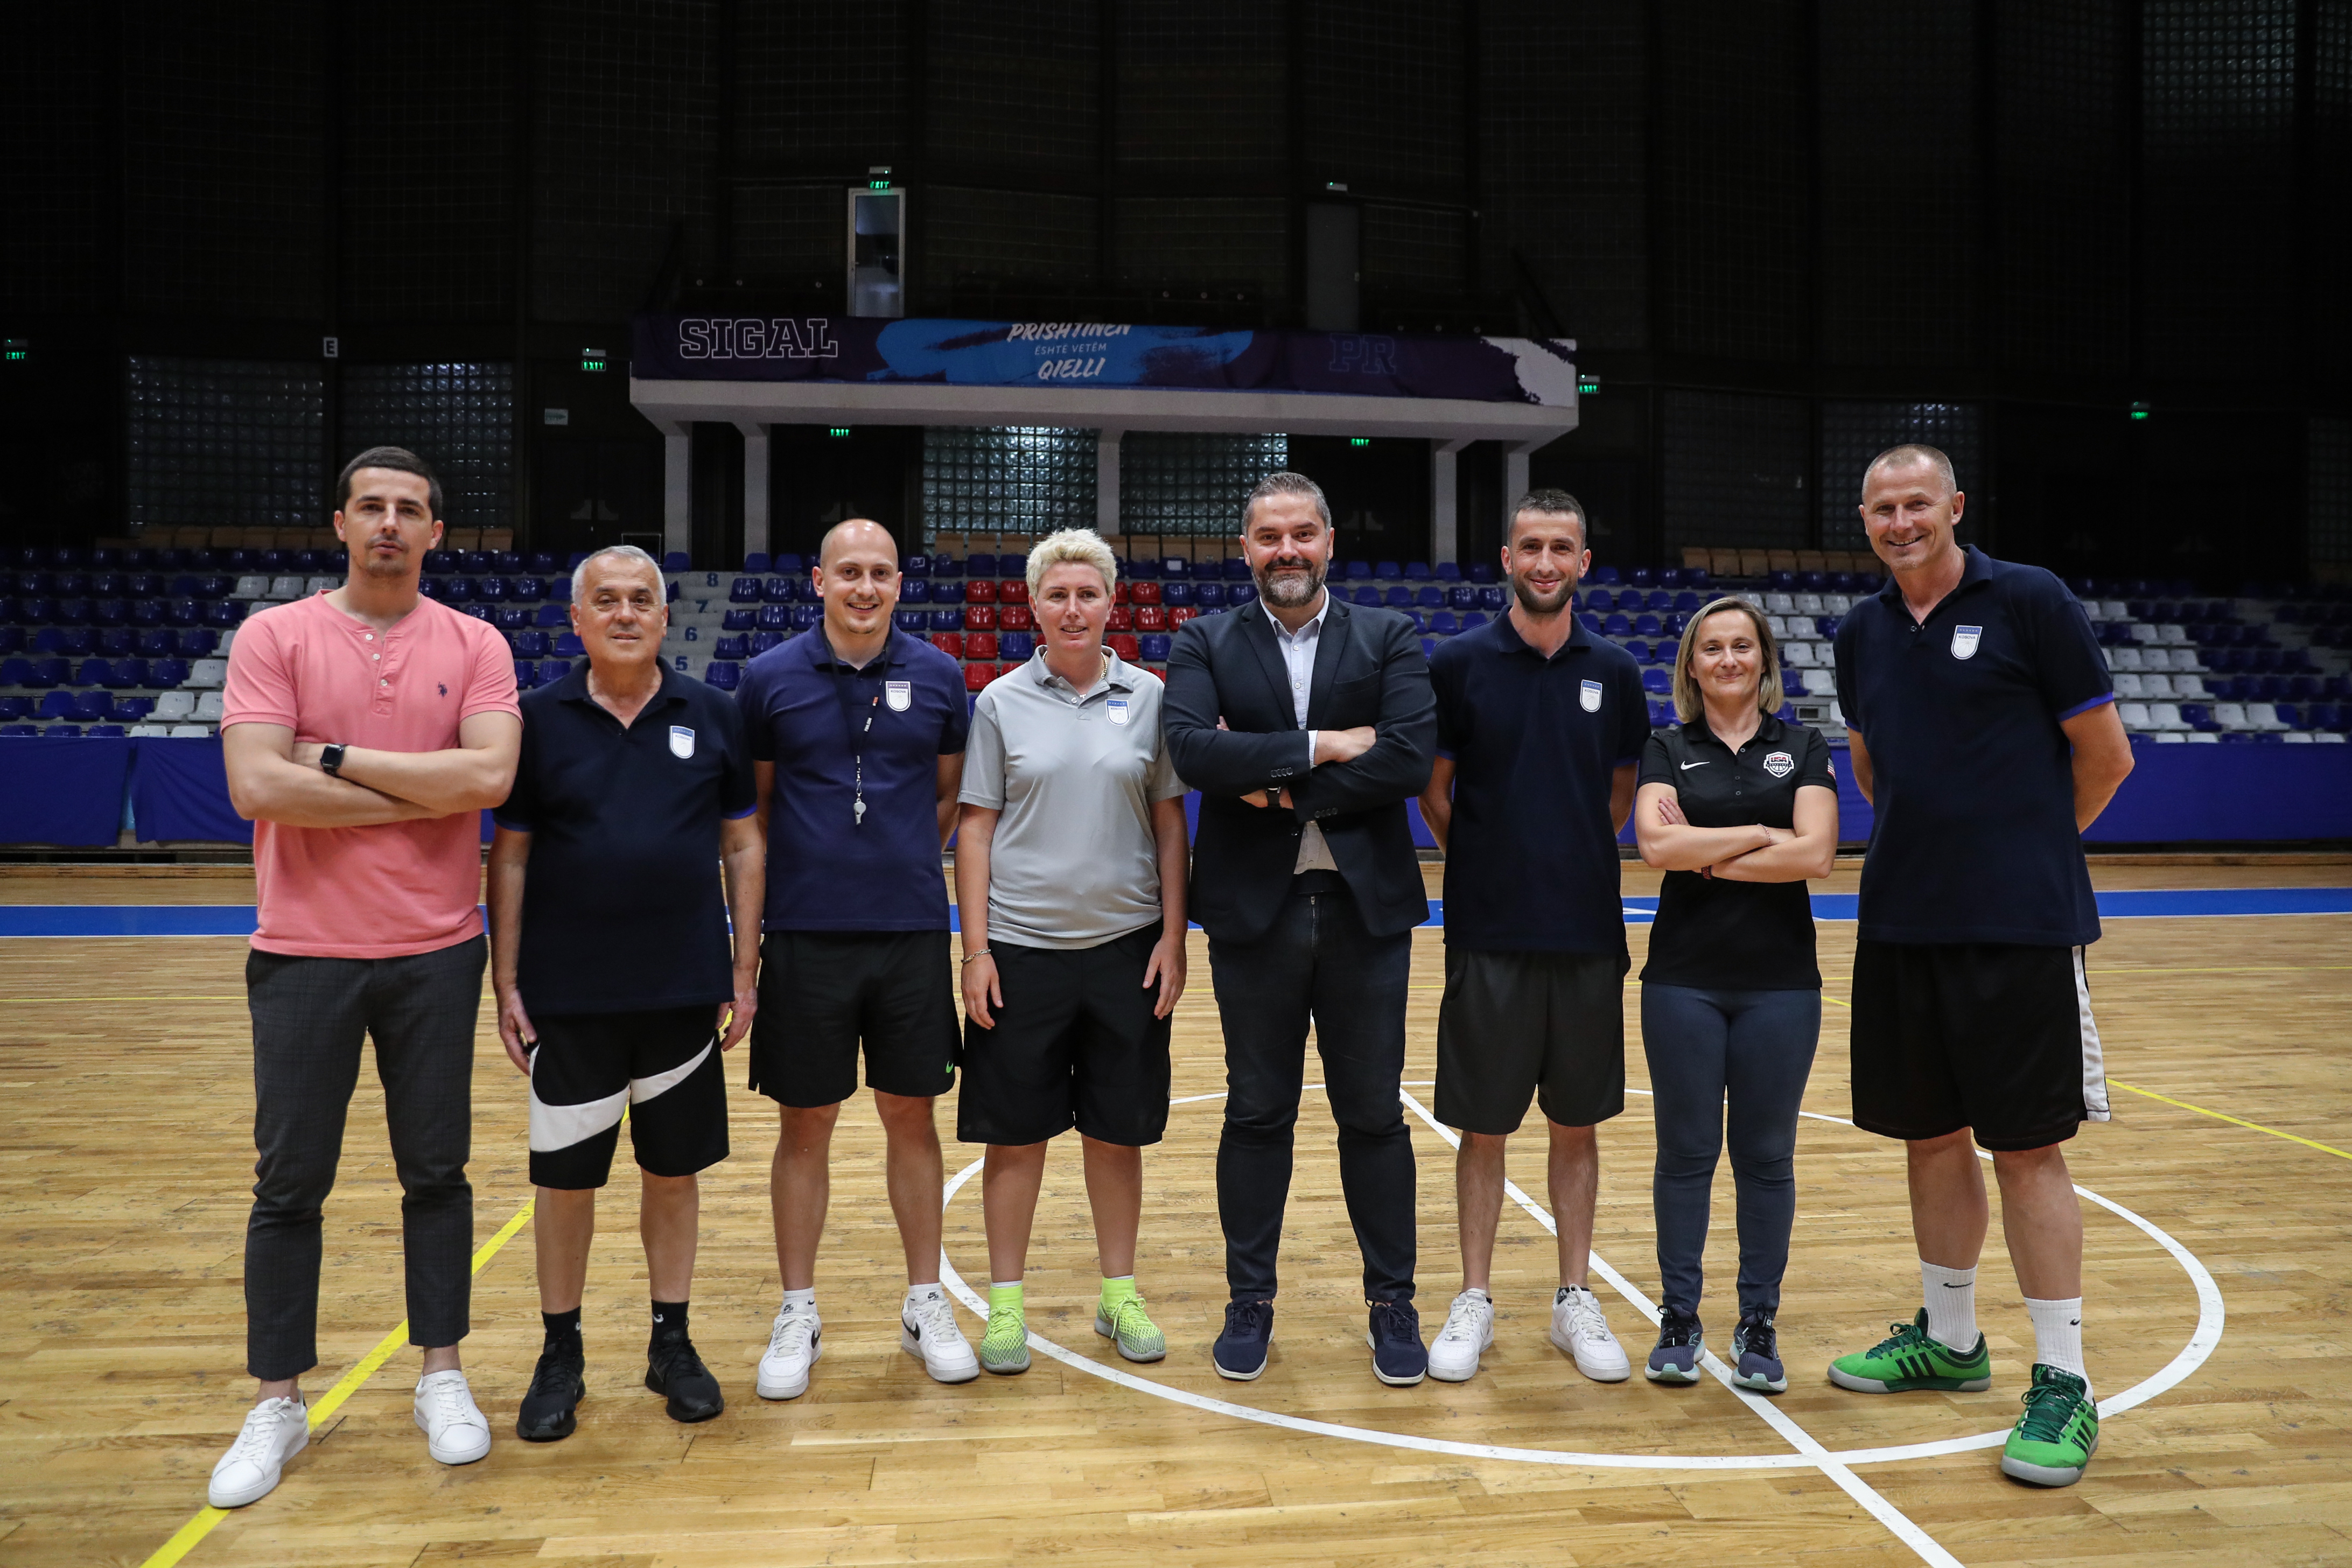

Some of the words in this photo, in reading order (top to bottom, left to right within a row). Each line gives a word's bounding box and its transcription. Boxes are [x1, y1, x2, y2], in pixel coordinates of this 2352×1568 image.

[679, 318, 838, 359] SIGAL
[326, 340, 335, 354] E
[1329, 333, 1397, 375] PR
[584, 361, 604, 369] EXIT
[1037, 357, 1106, 380] QIELLI
[707, 573, 719, 587] 8
[695, 600, 709, 613] 7
[685, 627, 697, 641] 6
[675, 656, 688, 671] 5
